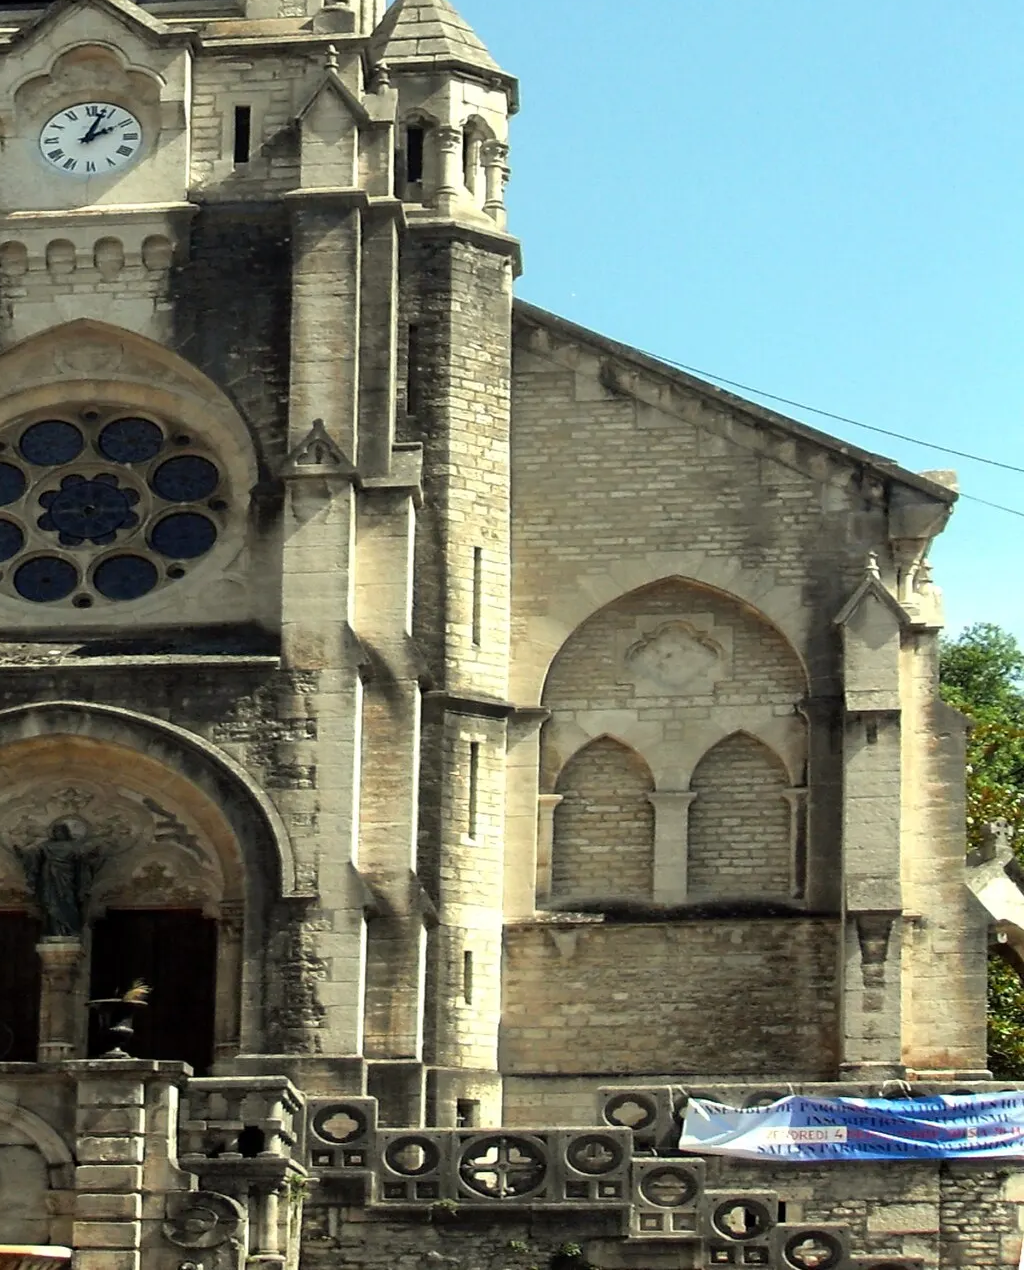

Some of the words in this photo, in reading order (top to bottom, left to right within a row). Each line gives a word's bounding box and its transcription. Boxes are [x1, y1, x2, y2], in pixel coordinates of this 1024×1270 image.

[911, 1114, 1009, 1125] CTECHISME
[765, 1129, 828, 1140] VEDREDI
[835, 1128, 843, 1138] 4
